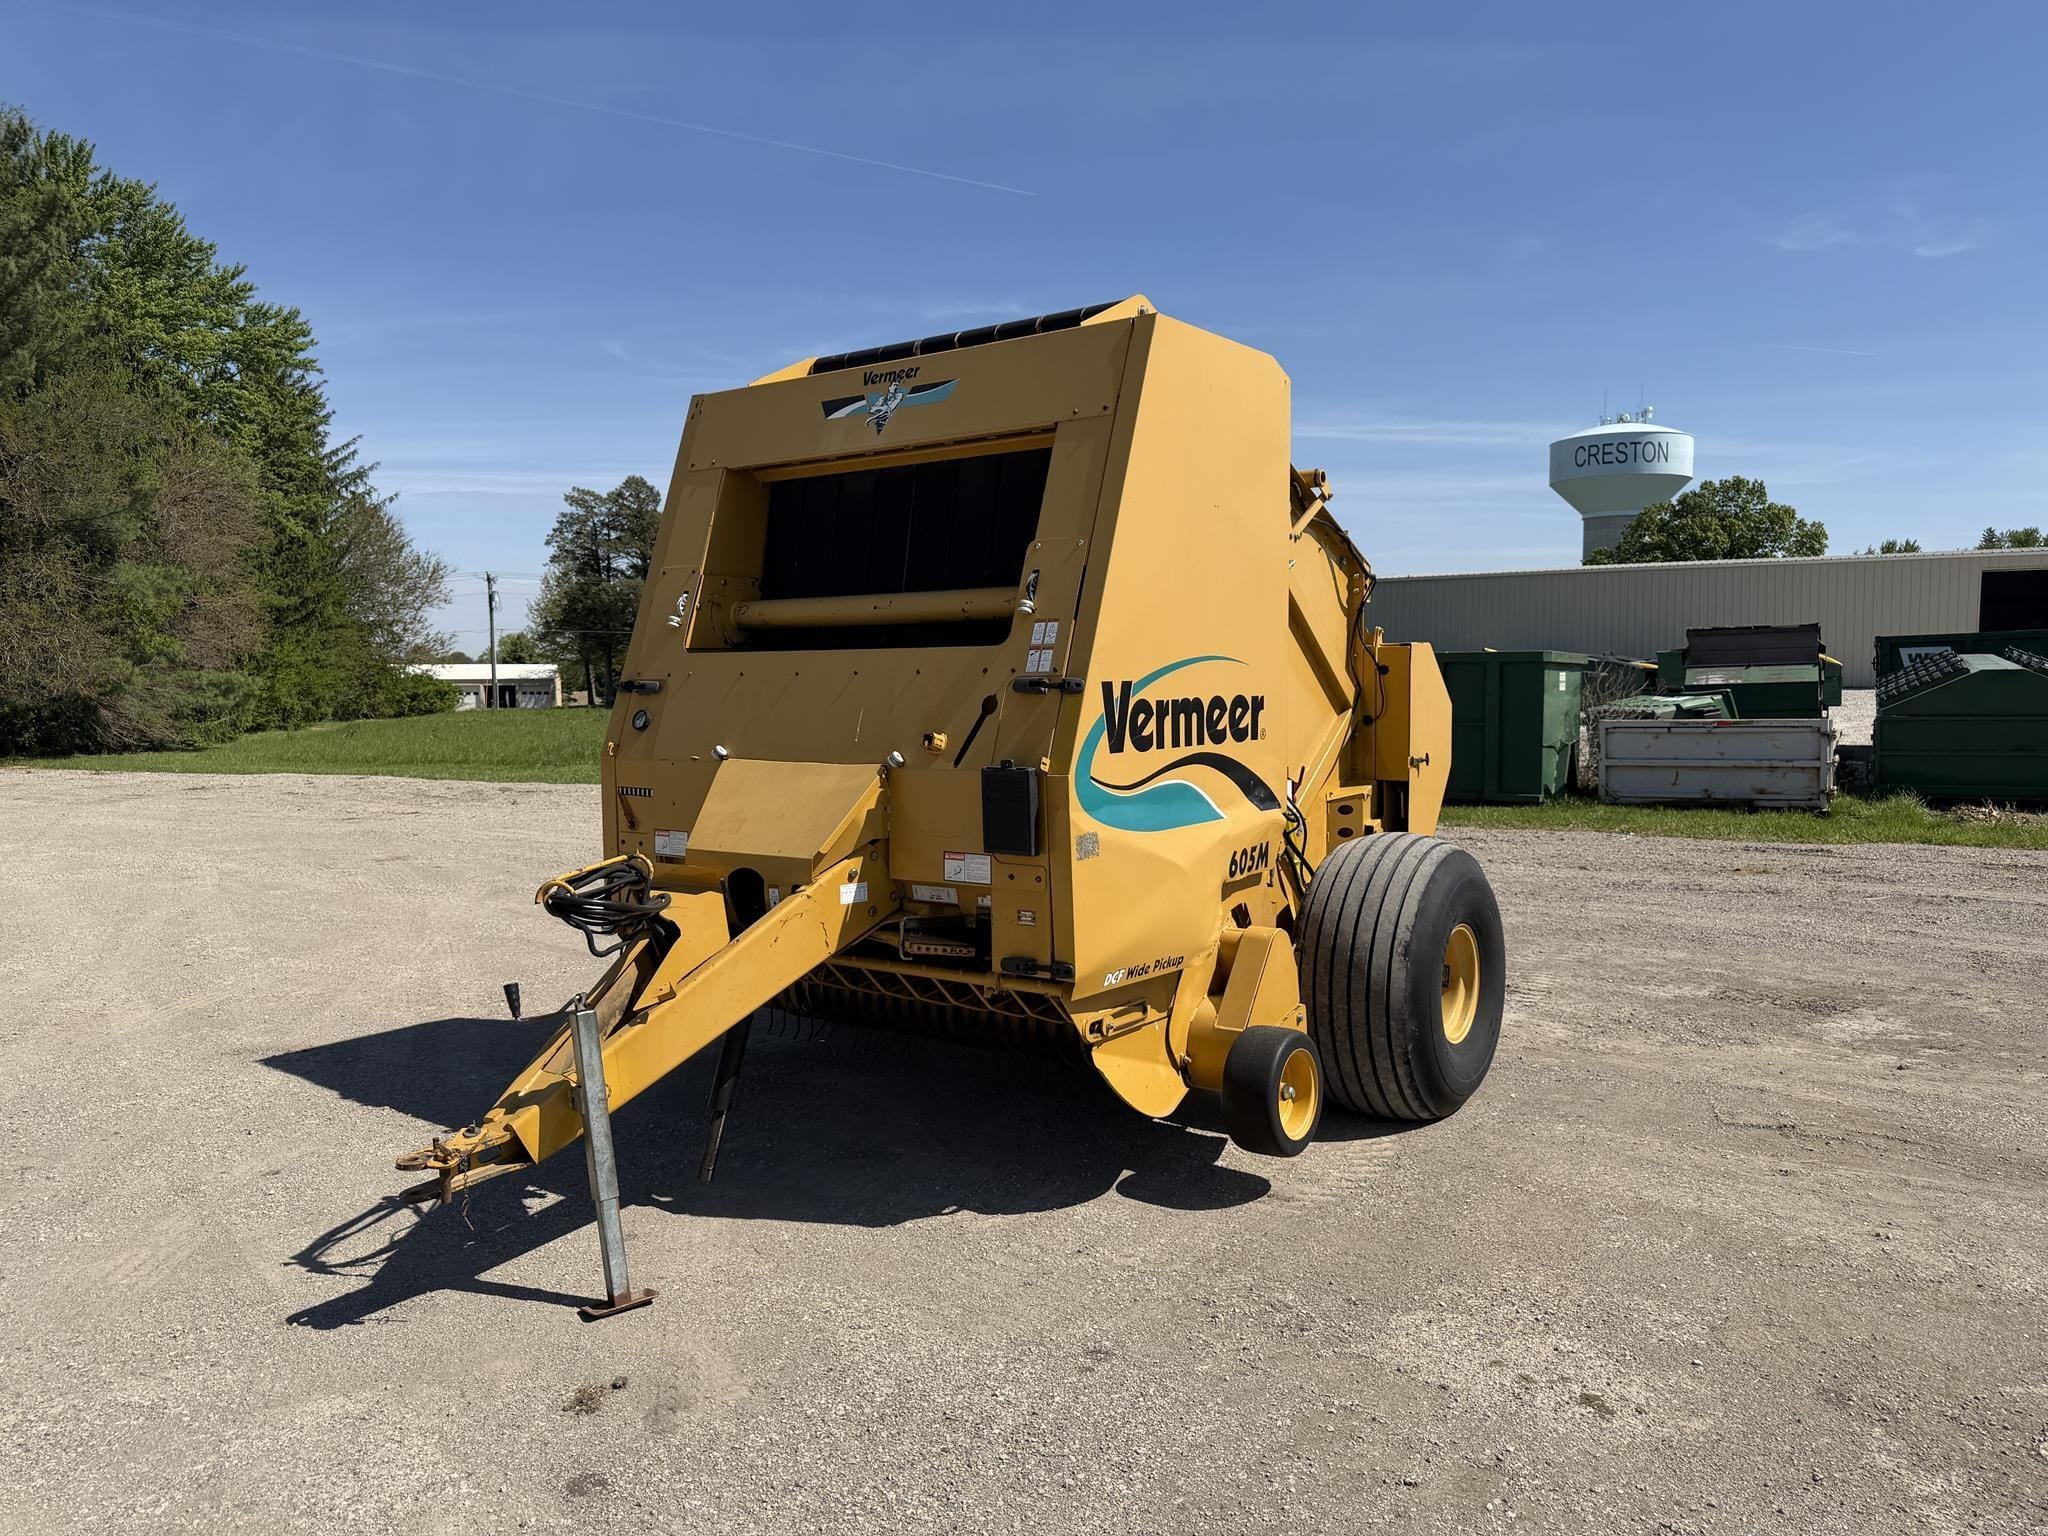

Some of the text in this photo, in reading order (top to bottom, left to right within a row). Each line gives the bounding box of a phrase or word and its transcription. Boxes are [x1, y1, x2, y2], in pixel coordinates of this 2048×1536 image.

[863, 366, 920, 386] Vermeer
[1574, 441, 1669, 467] CRESTON
[1101, 680, 1265, 754] Vermeer
[1229, 840, 1269, 878] 605M
[1104, 955, 1184, 987] DCF Wide Pickup
